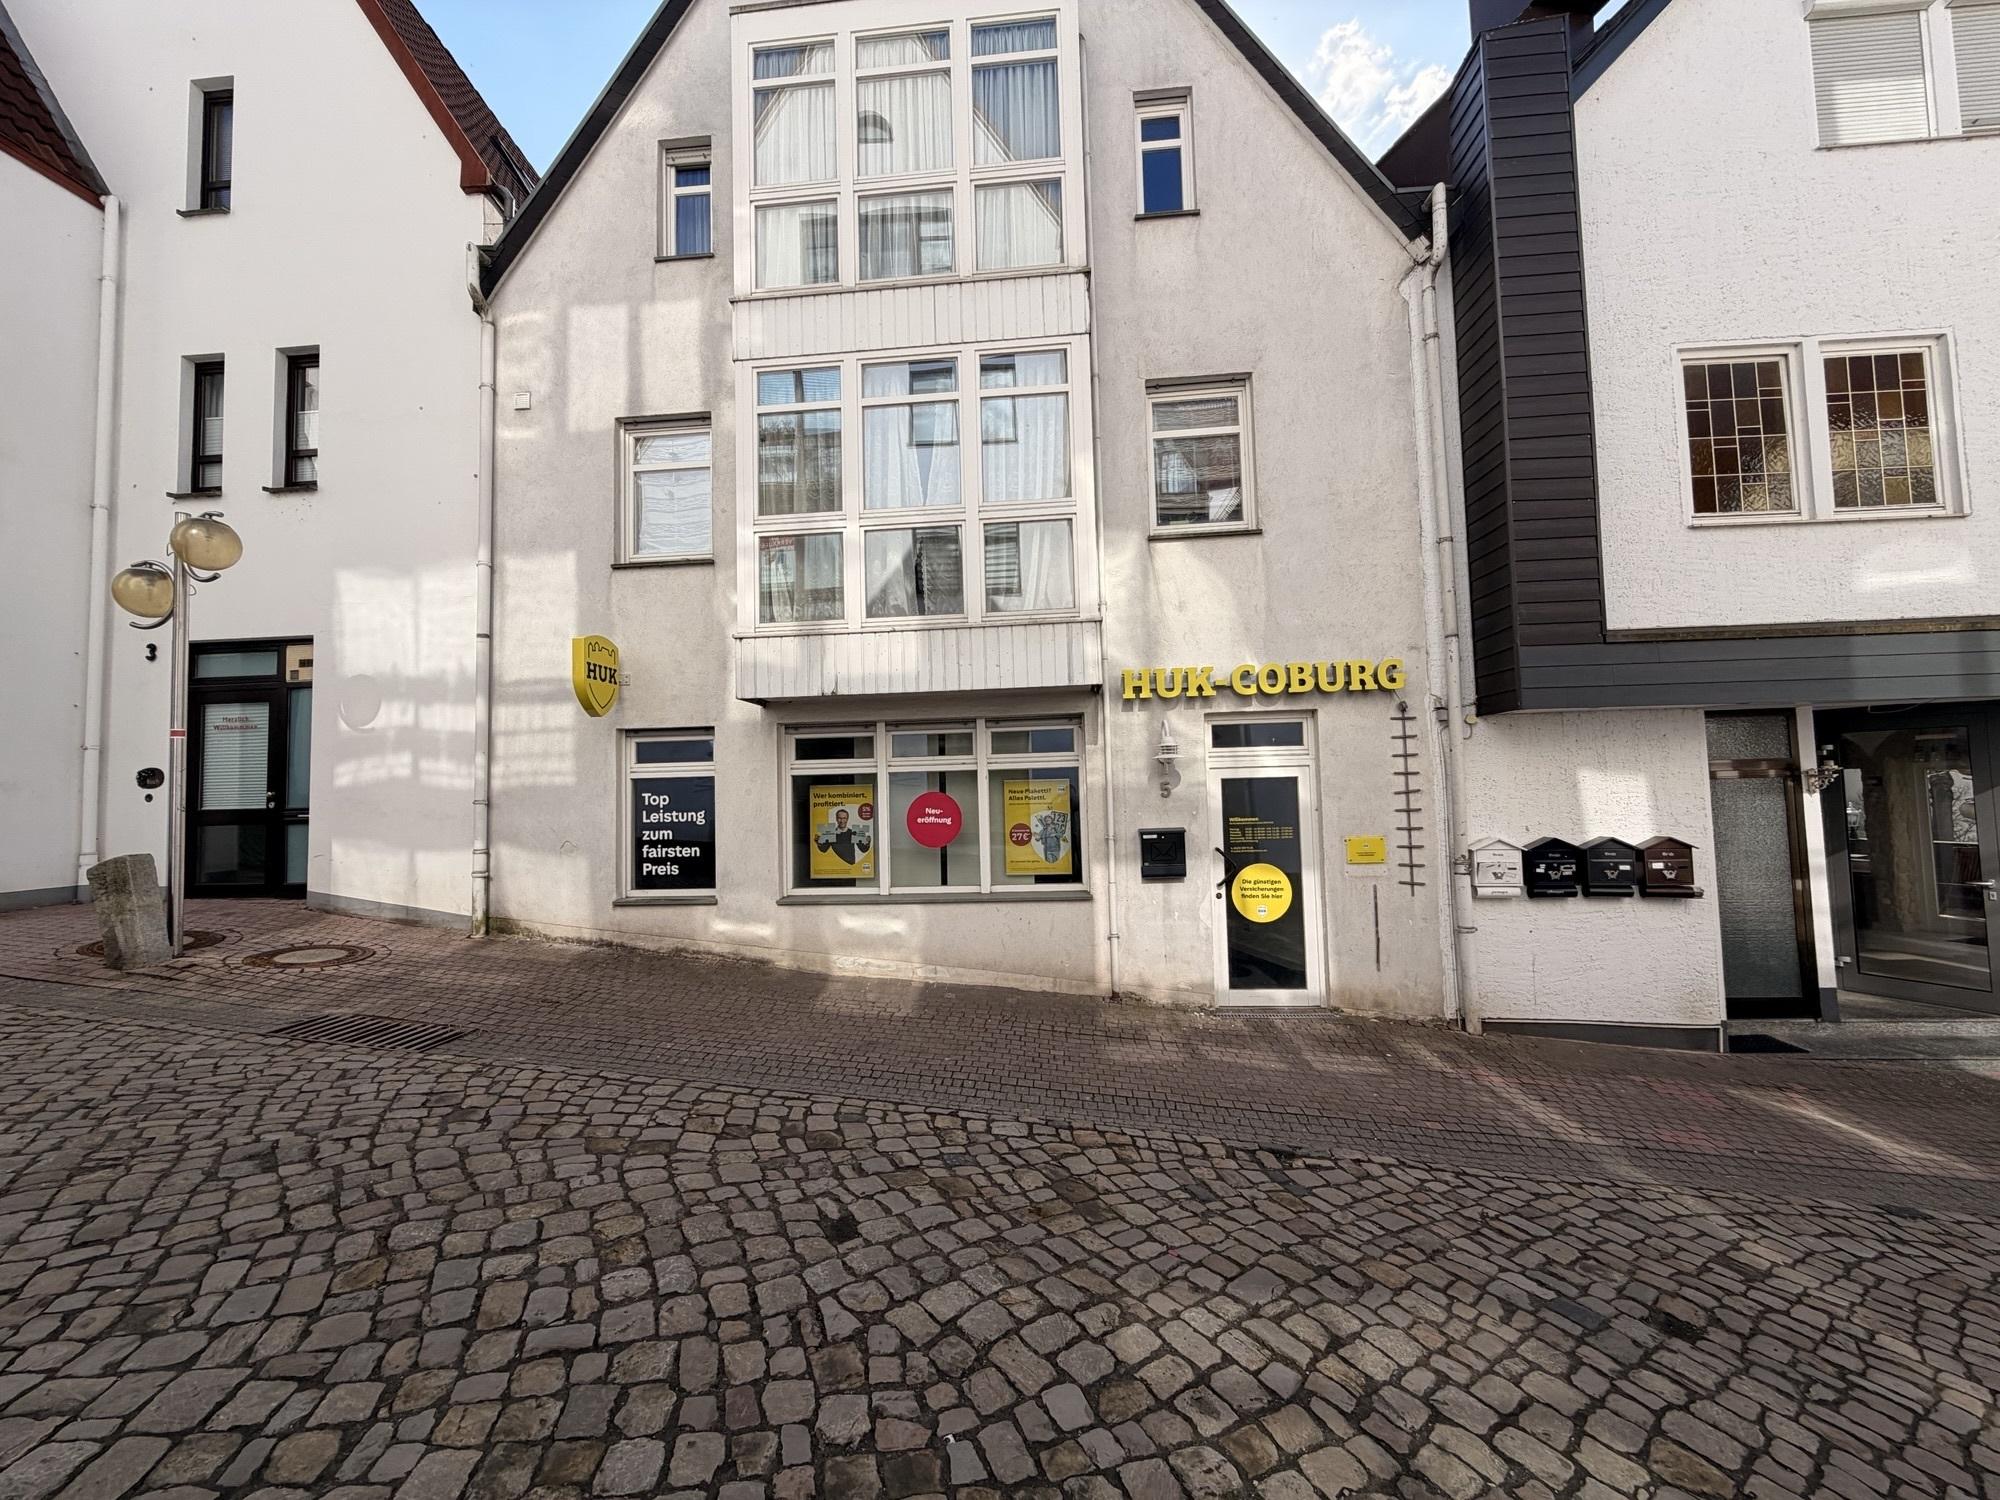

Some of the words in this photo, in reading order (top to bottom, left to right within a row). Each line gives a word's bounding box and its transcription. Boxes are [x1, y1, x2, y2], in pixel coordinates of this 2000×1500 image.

[145, 643, 157, 662] 3
[586, 661, 618, 685] HUK
[1121, 658, 1408, 699] HUK-COBURG
[1160, 782, 1171, 798] 5
[641, 793, 670, 808] Top
[642, 809, 706, 825] Leistung
[917, 816, 952, 825] eröffnung
[642, 830, 673, 841] zum
[641, 844, 700, 858] fairsten
[642, 862, 679, 876] Preis
[1253, 878, 1282, 886] günstigen
